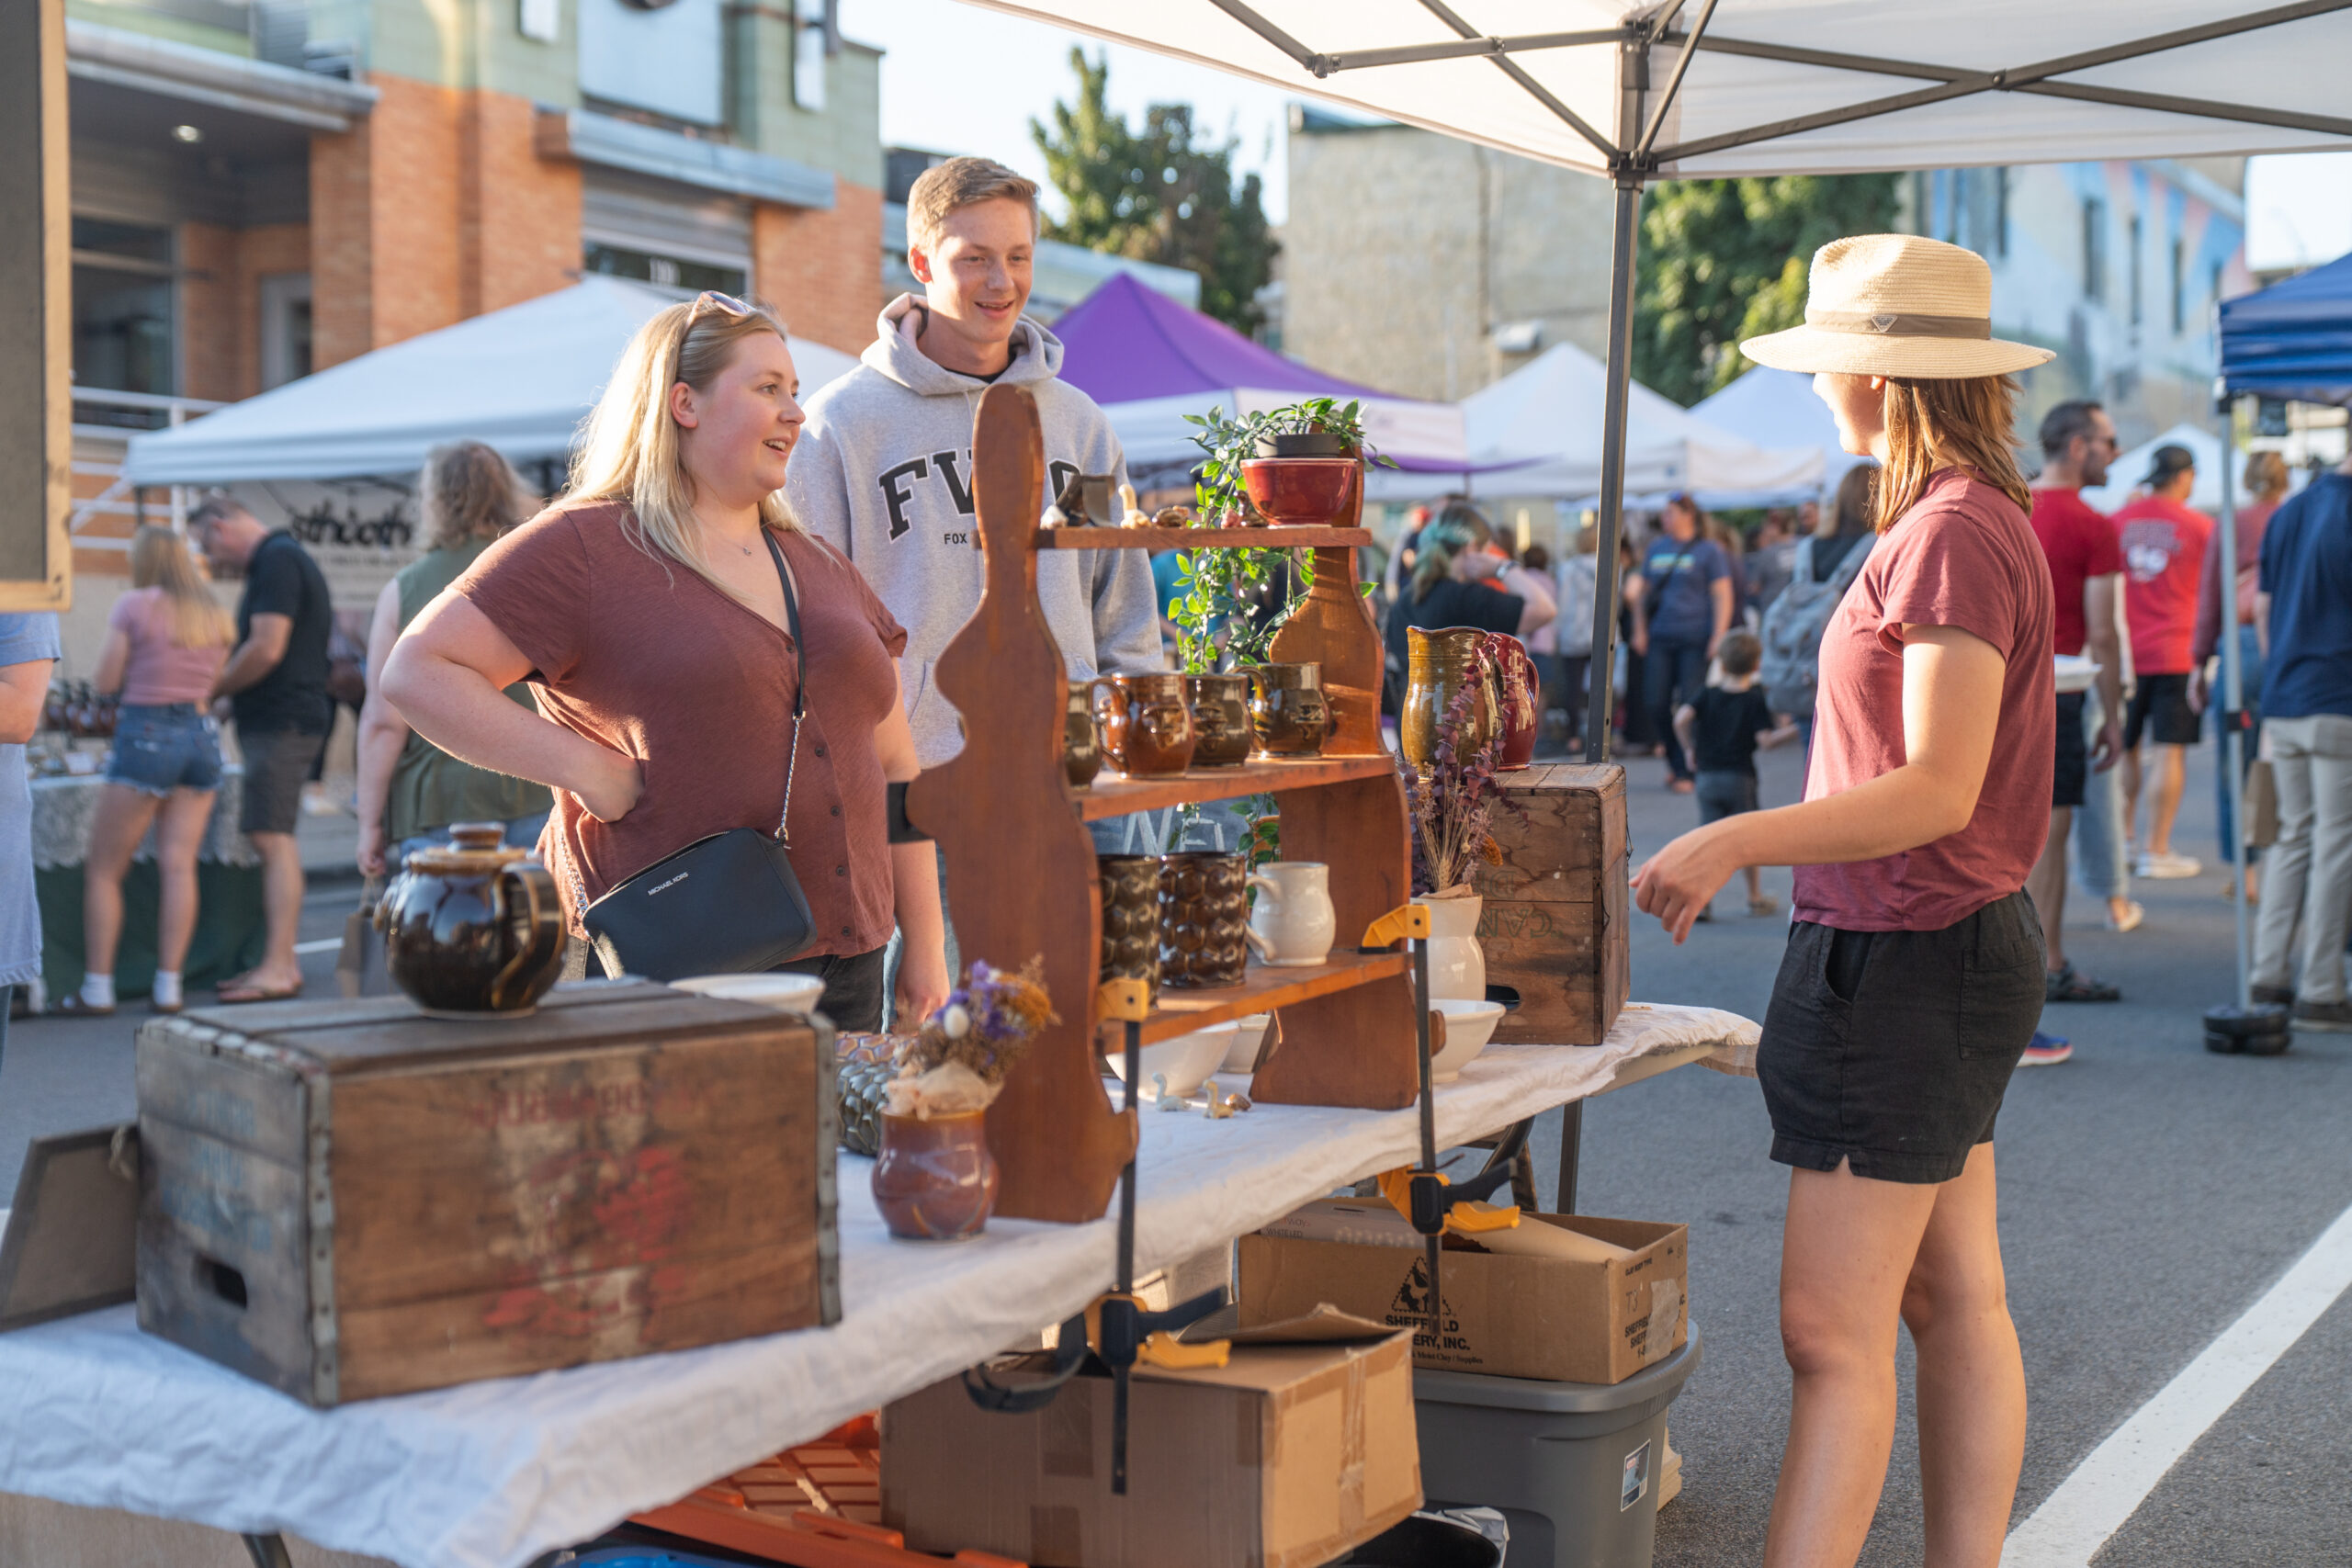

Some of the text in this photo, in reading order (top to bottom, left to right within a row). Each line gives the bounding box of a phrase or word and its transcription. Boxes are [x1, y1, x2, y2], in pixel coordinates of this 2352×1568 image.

[944, 533, 967, 545] FOX
[648, 872, 688, 896] MICHAEL KORS
[1289, 1229, 1303, 1238] LED
[1385, 1314, 1459, 1333] SHEFFLD
[1443, 1337, 1471, 1350] INC.
